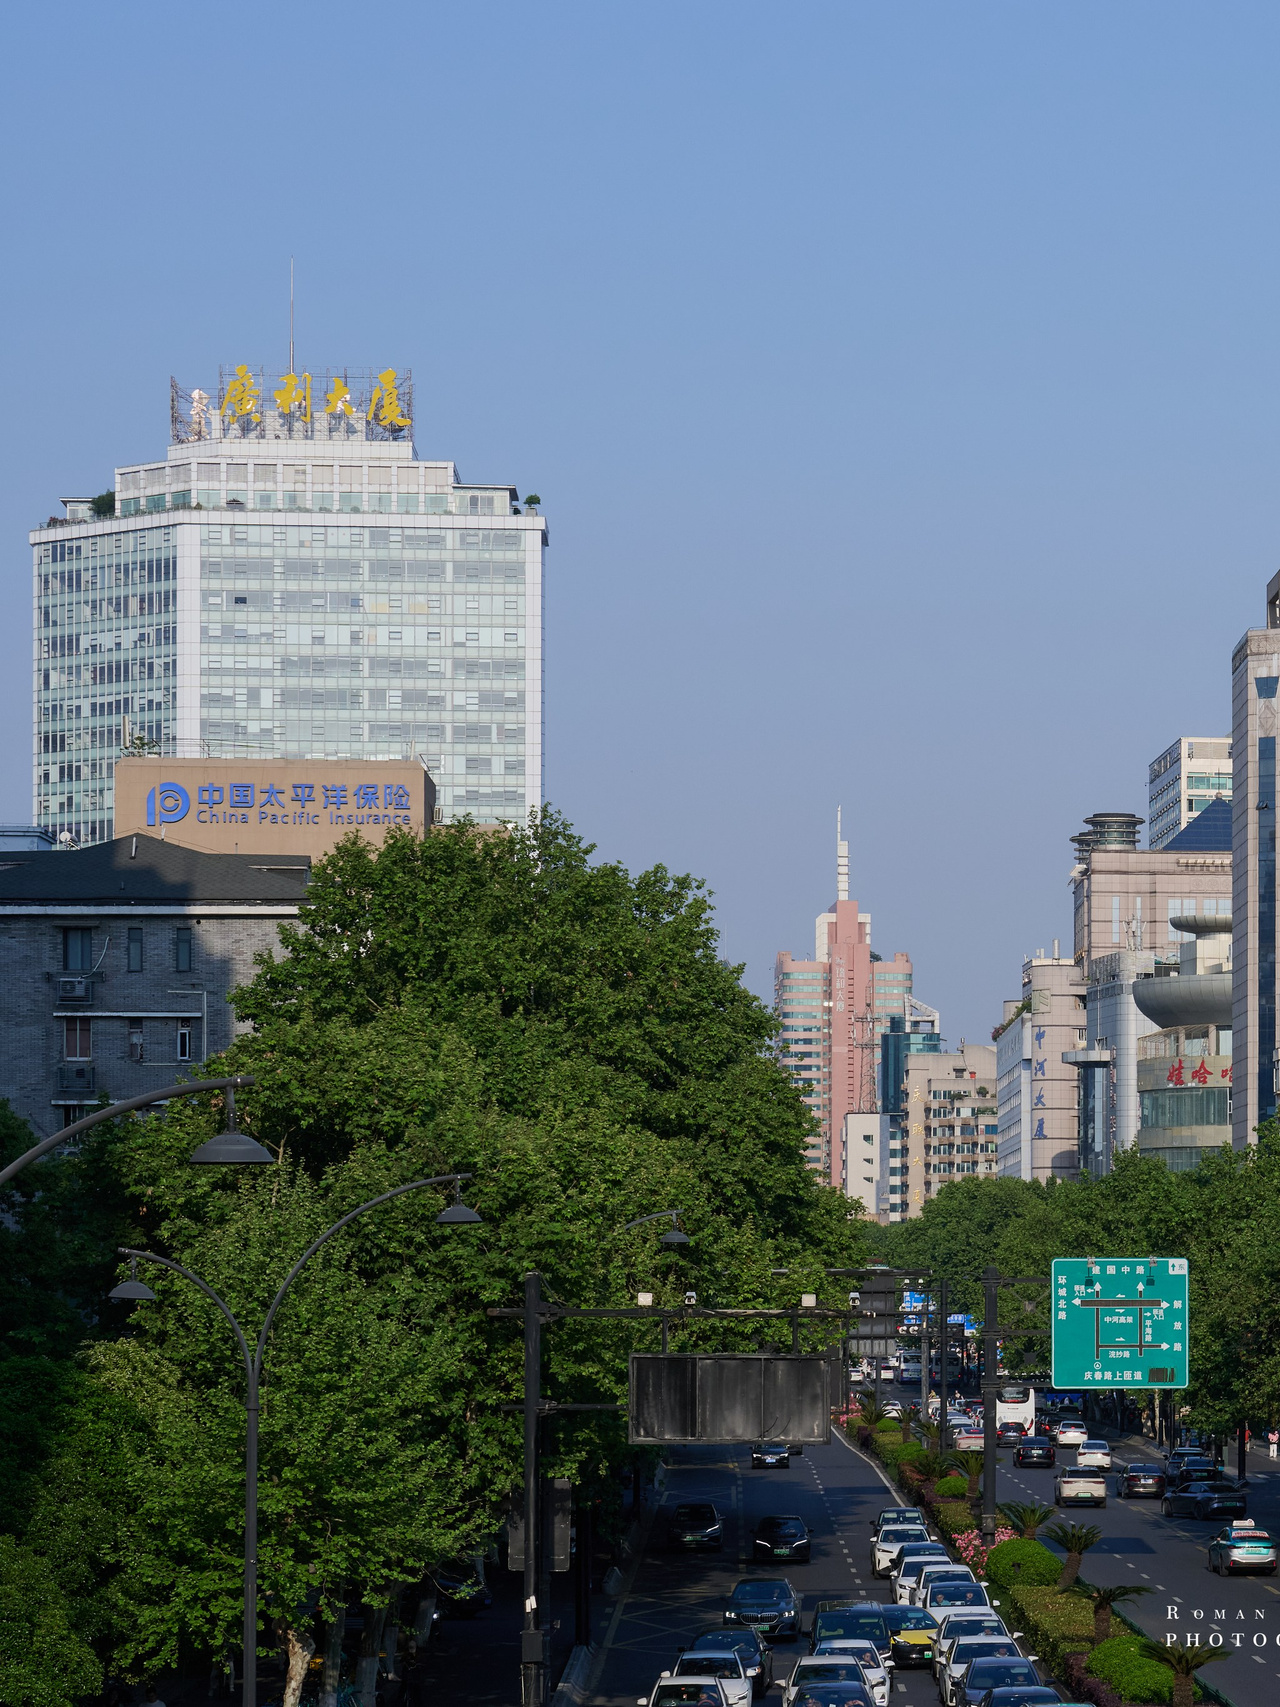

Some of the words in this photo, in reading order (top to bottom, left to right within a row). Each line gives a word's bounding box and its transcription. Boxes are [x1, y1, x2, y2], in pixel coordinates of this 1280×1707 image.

[198, 782, 412, 810] 中国太平洋保险
[196, 810, 249, 825] China
[258, 810, 319, 825] Pacific
[329, 811, 411, 825] Insurance
[1092, 1265, 1145, 1274] 建国中路
[1058, 1275, 1067, 1320] 环城北路
[1173, 1300, 1183, 1351] 解放路
